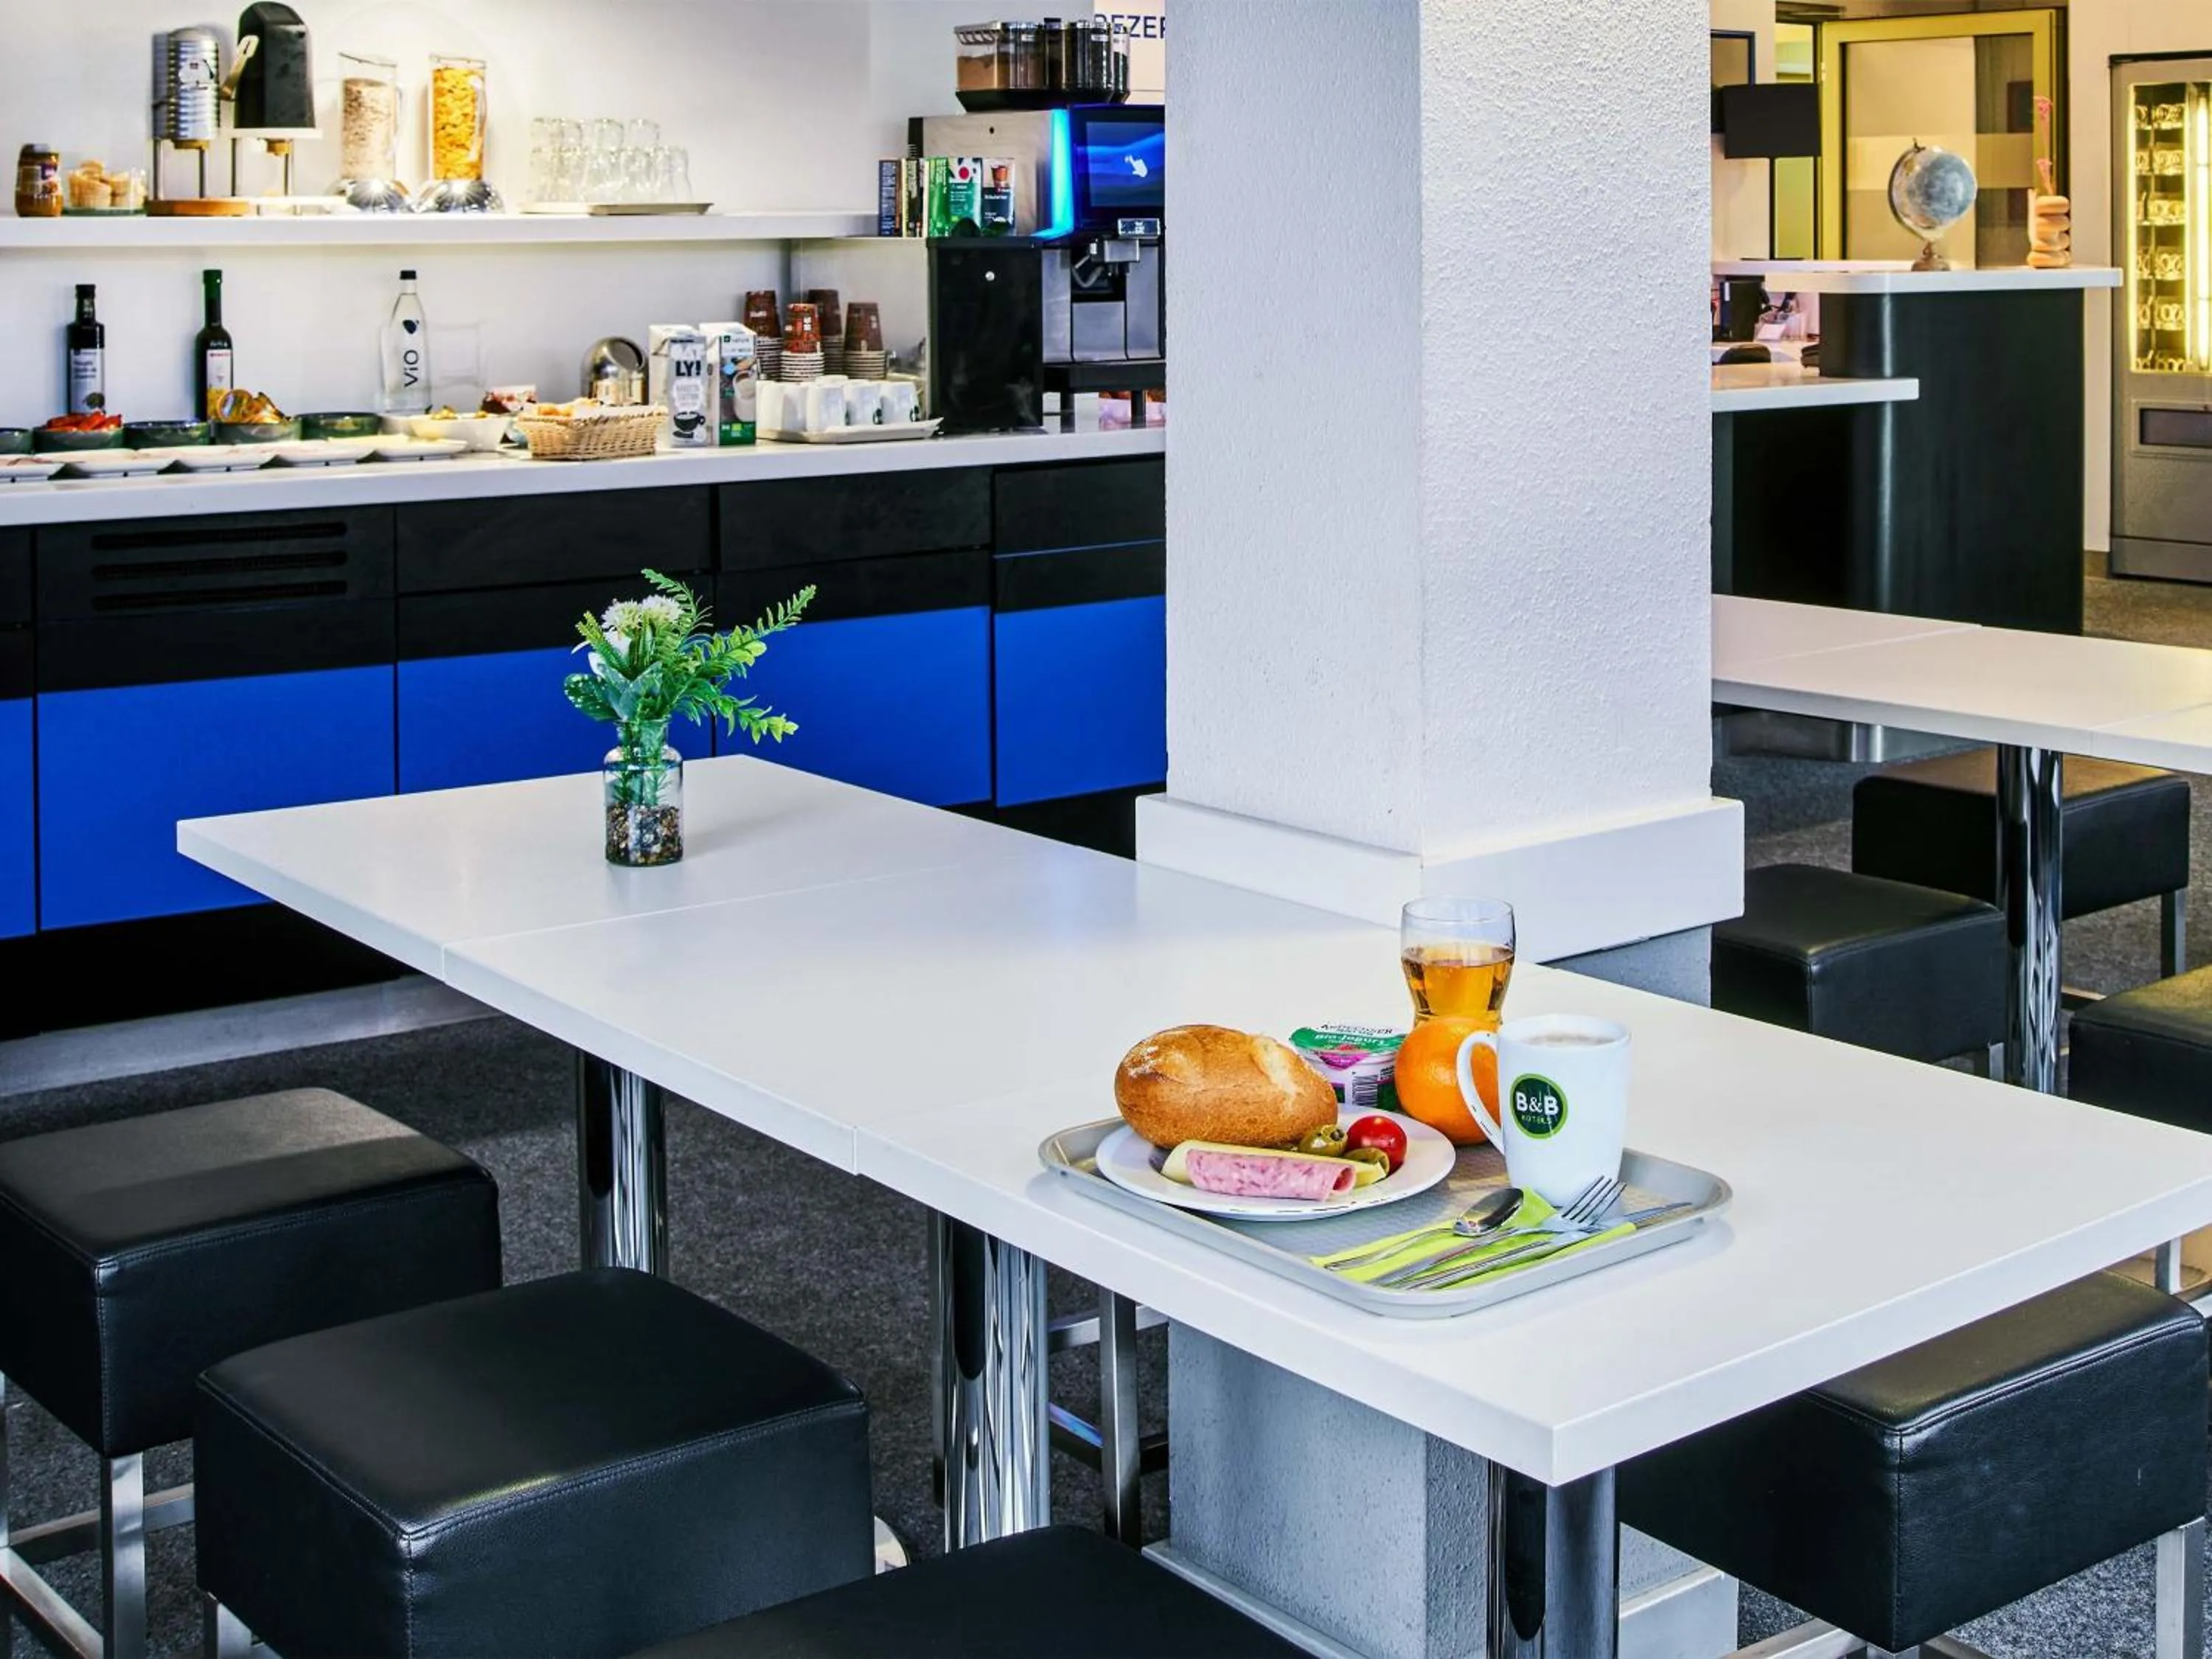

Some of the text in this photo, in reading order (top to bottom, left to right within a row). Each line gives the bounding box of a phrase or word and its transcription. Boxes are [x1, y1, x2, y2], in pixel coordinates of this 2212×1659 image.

[403, 349, 419, 387] ViO
[675, 359, 701, 377] LY!
[1516, 1091, 1559, 1116] B&B
